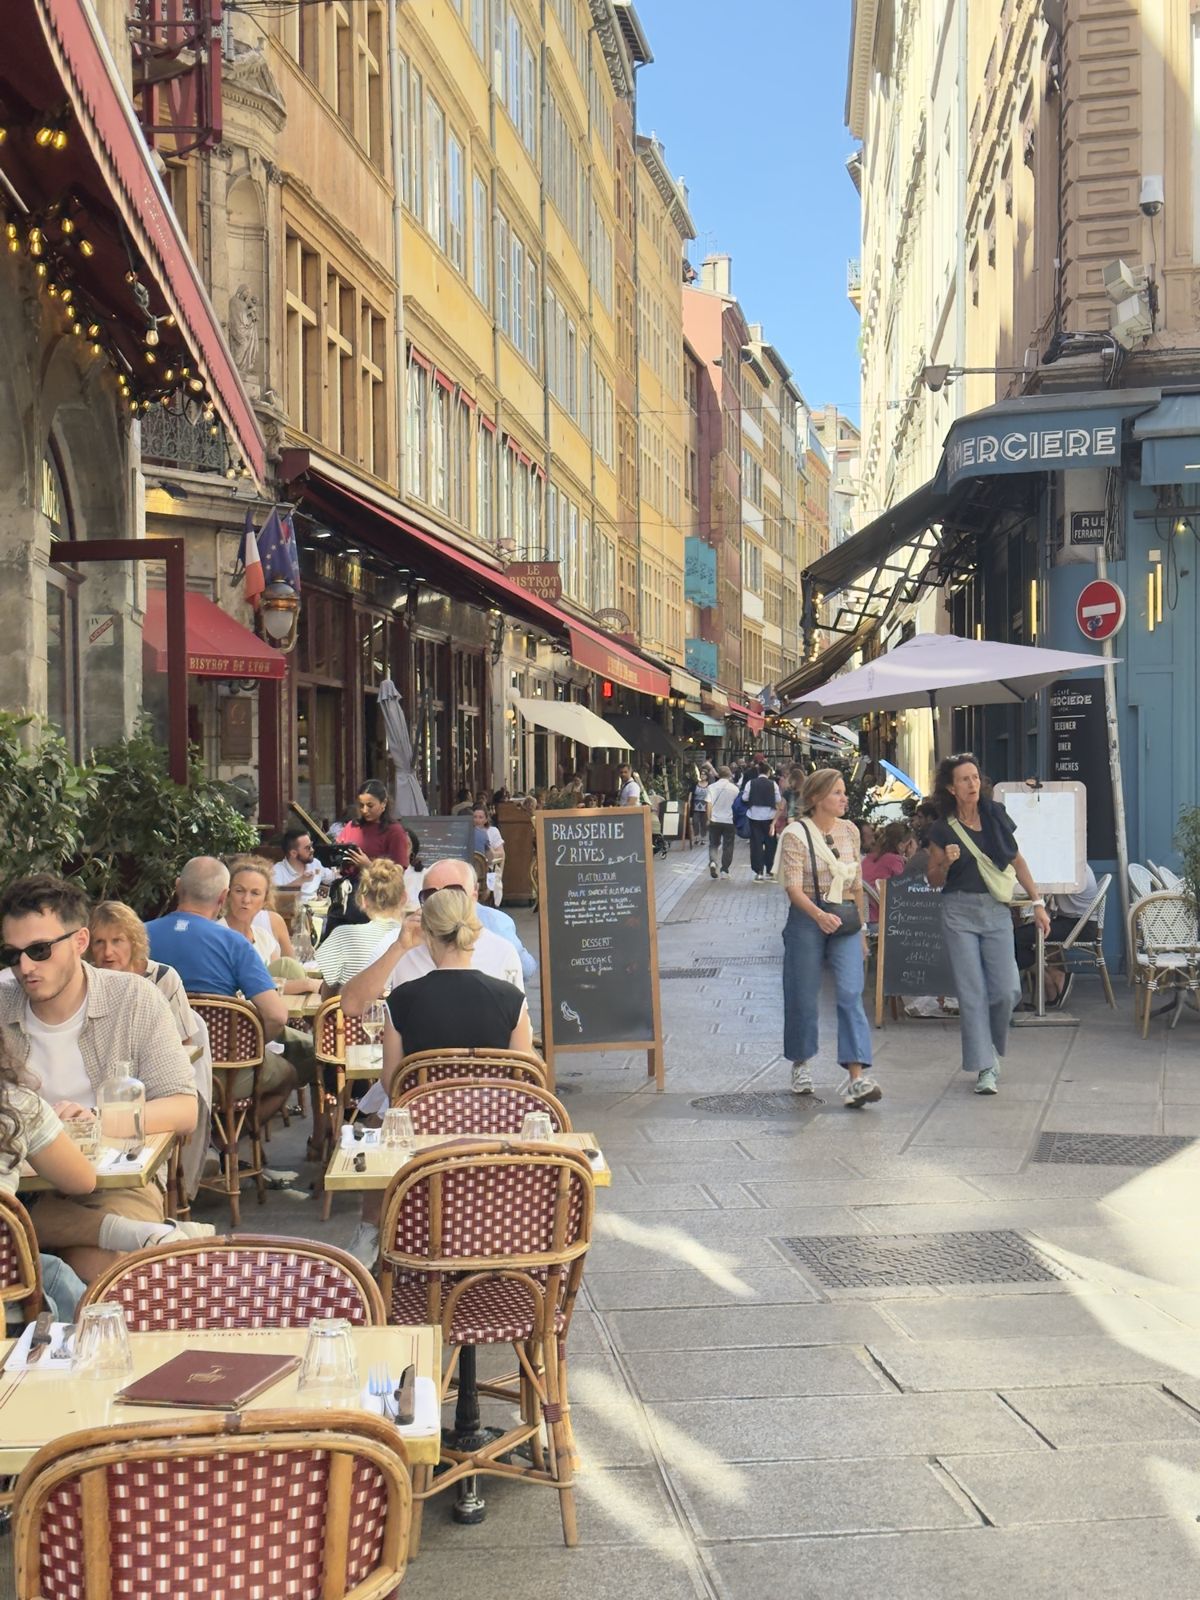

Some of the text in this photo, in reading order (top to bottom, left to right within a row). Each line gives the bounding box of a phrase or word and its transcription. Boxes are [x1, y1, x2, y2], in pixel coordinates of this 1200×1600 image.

[1074, 529, 1104, 539] FERRANDI
[527, 564, 540, 576] LE
[190, 657, 271, 673] BISTROT DE LYON
[552, 823, 625, 840] BRASSERIE
[555, 844, 605, 866] 2 RIVES
[581, 936, 613, 949] DESSERT
[571, 955, 613, 967] CHEESECAKE
